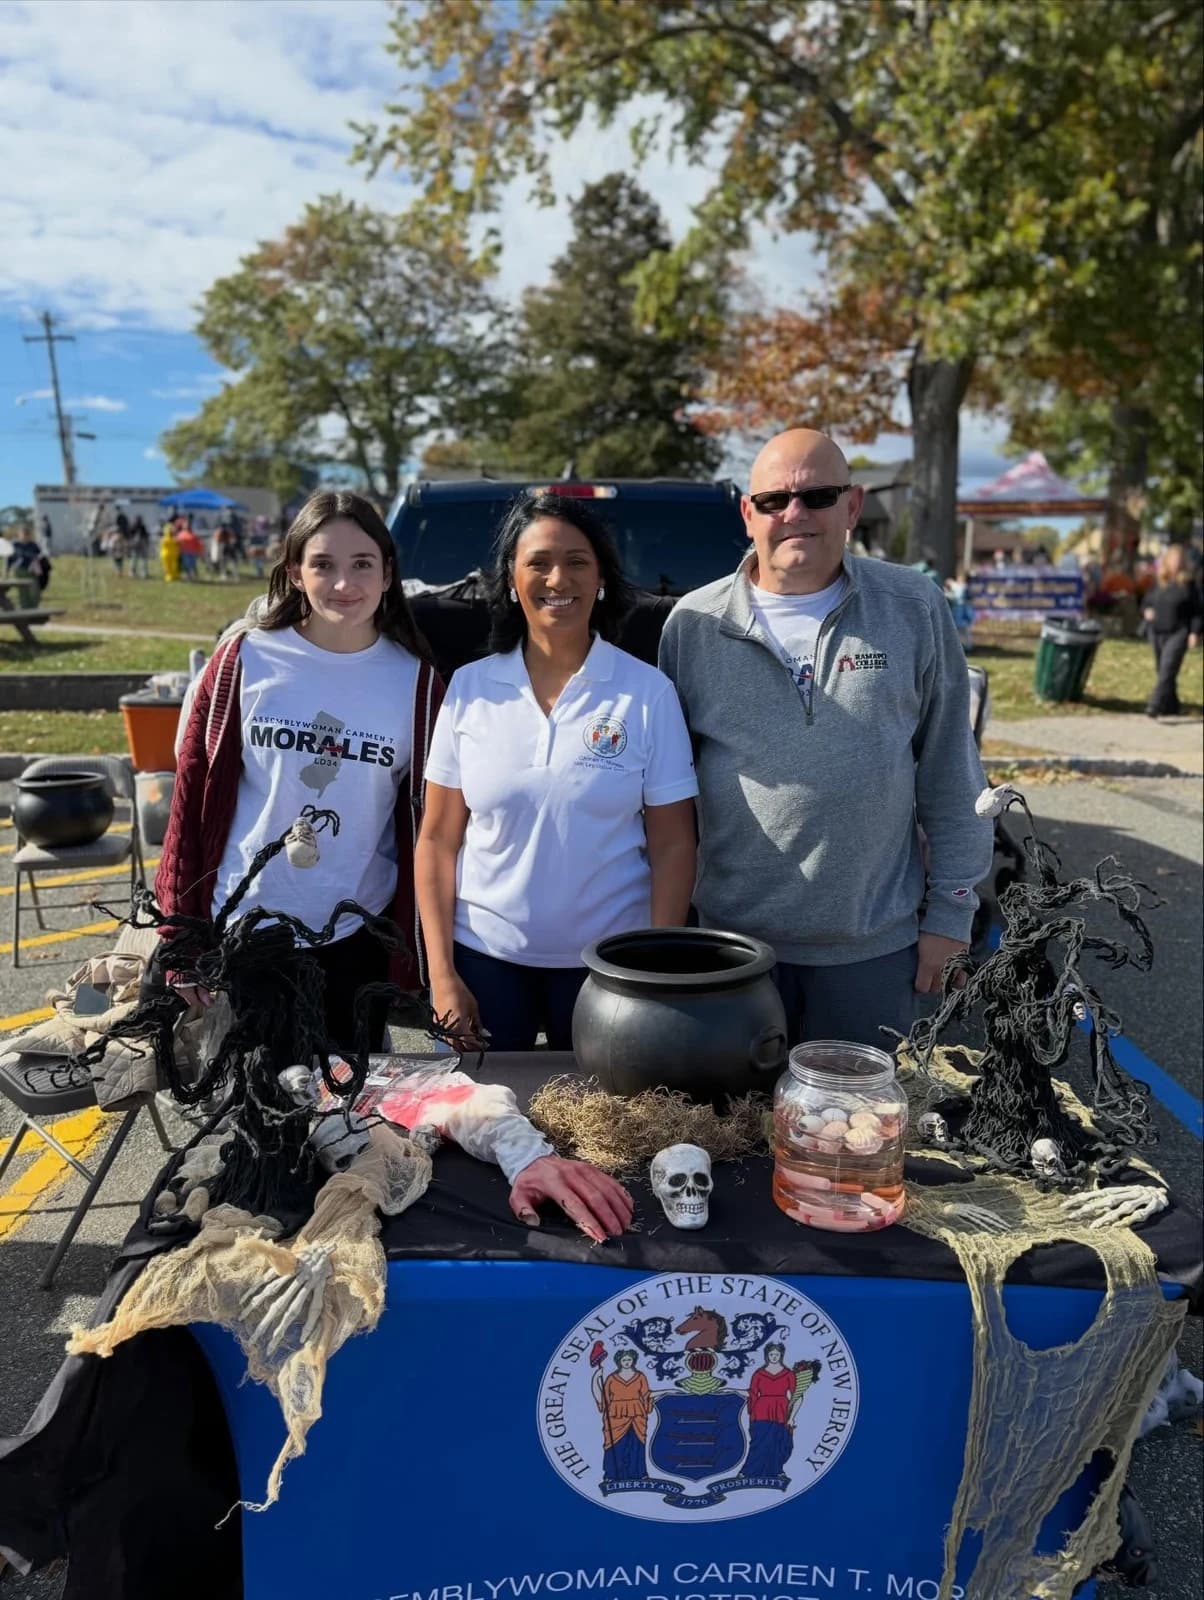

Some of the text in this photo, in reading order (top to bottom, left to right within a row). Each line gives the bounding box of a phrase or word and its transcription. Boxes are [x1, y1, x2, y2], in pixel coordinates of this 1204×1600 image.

[251, 716, 342, 735] ASSEMBLYWOMAN
[345, 729, 386, 742] CARMEN
[250, 725, 396, 768] MORALES
[314, 757, 338, 768] LD34
[545, 1275, 852, 1480] THE GREAT SEAL OF THE STATE OF NEW JERSEY
[606, 1478, 786, 1494] LIBERTY AND PROSPERITY
[681, 1497, 709, 1506] 1776
[673, 1562, 836, 1588] CARMEN
[847, 1568, 873, 1593] T.
